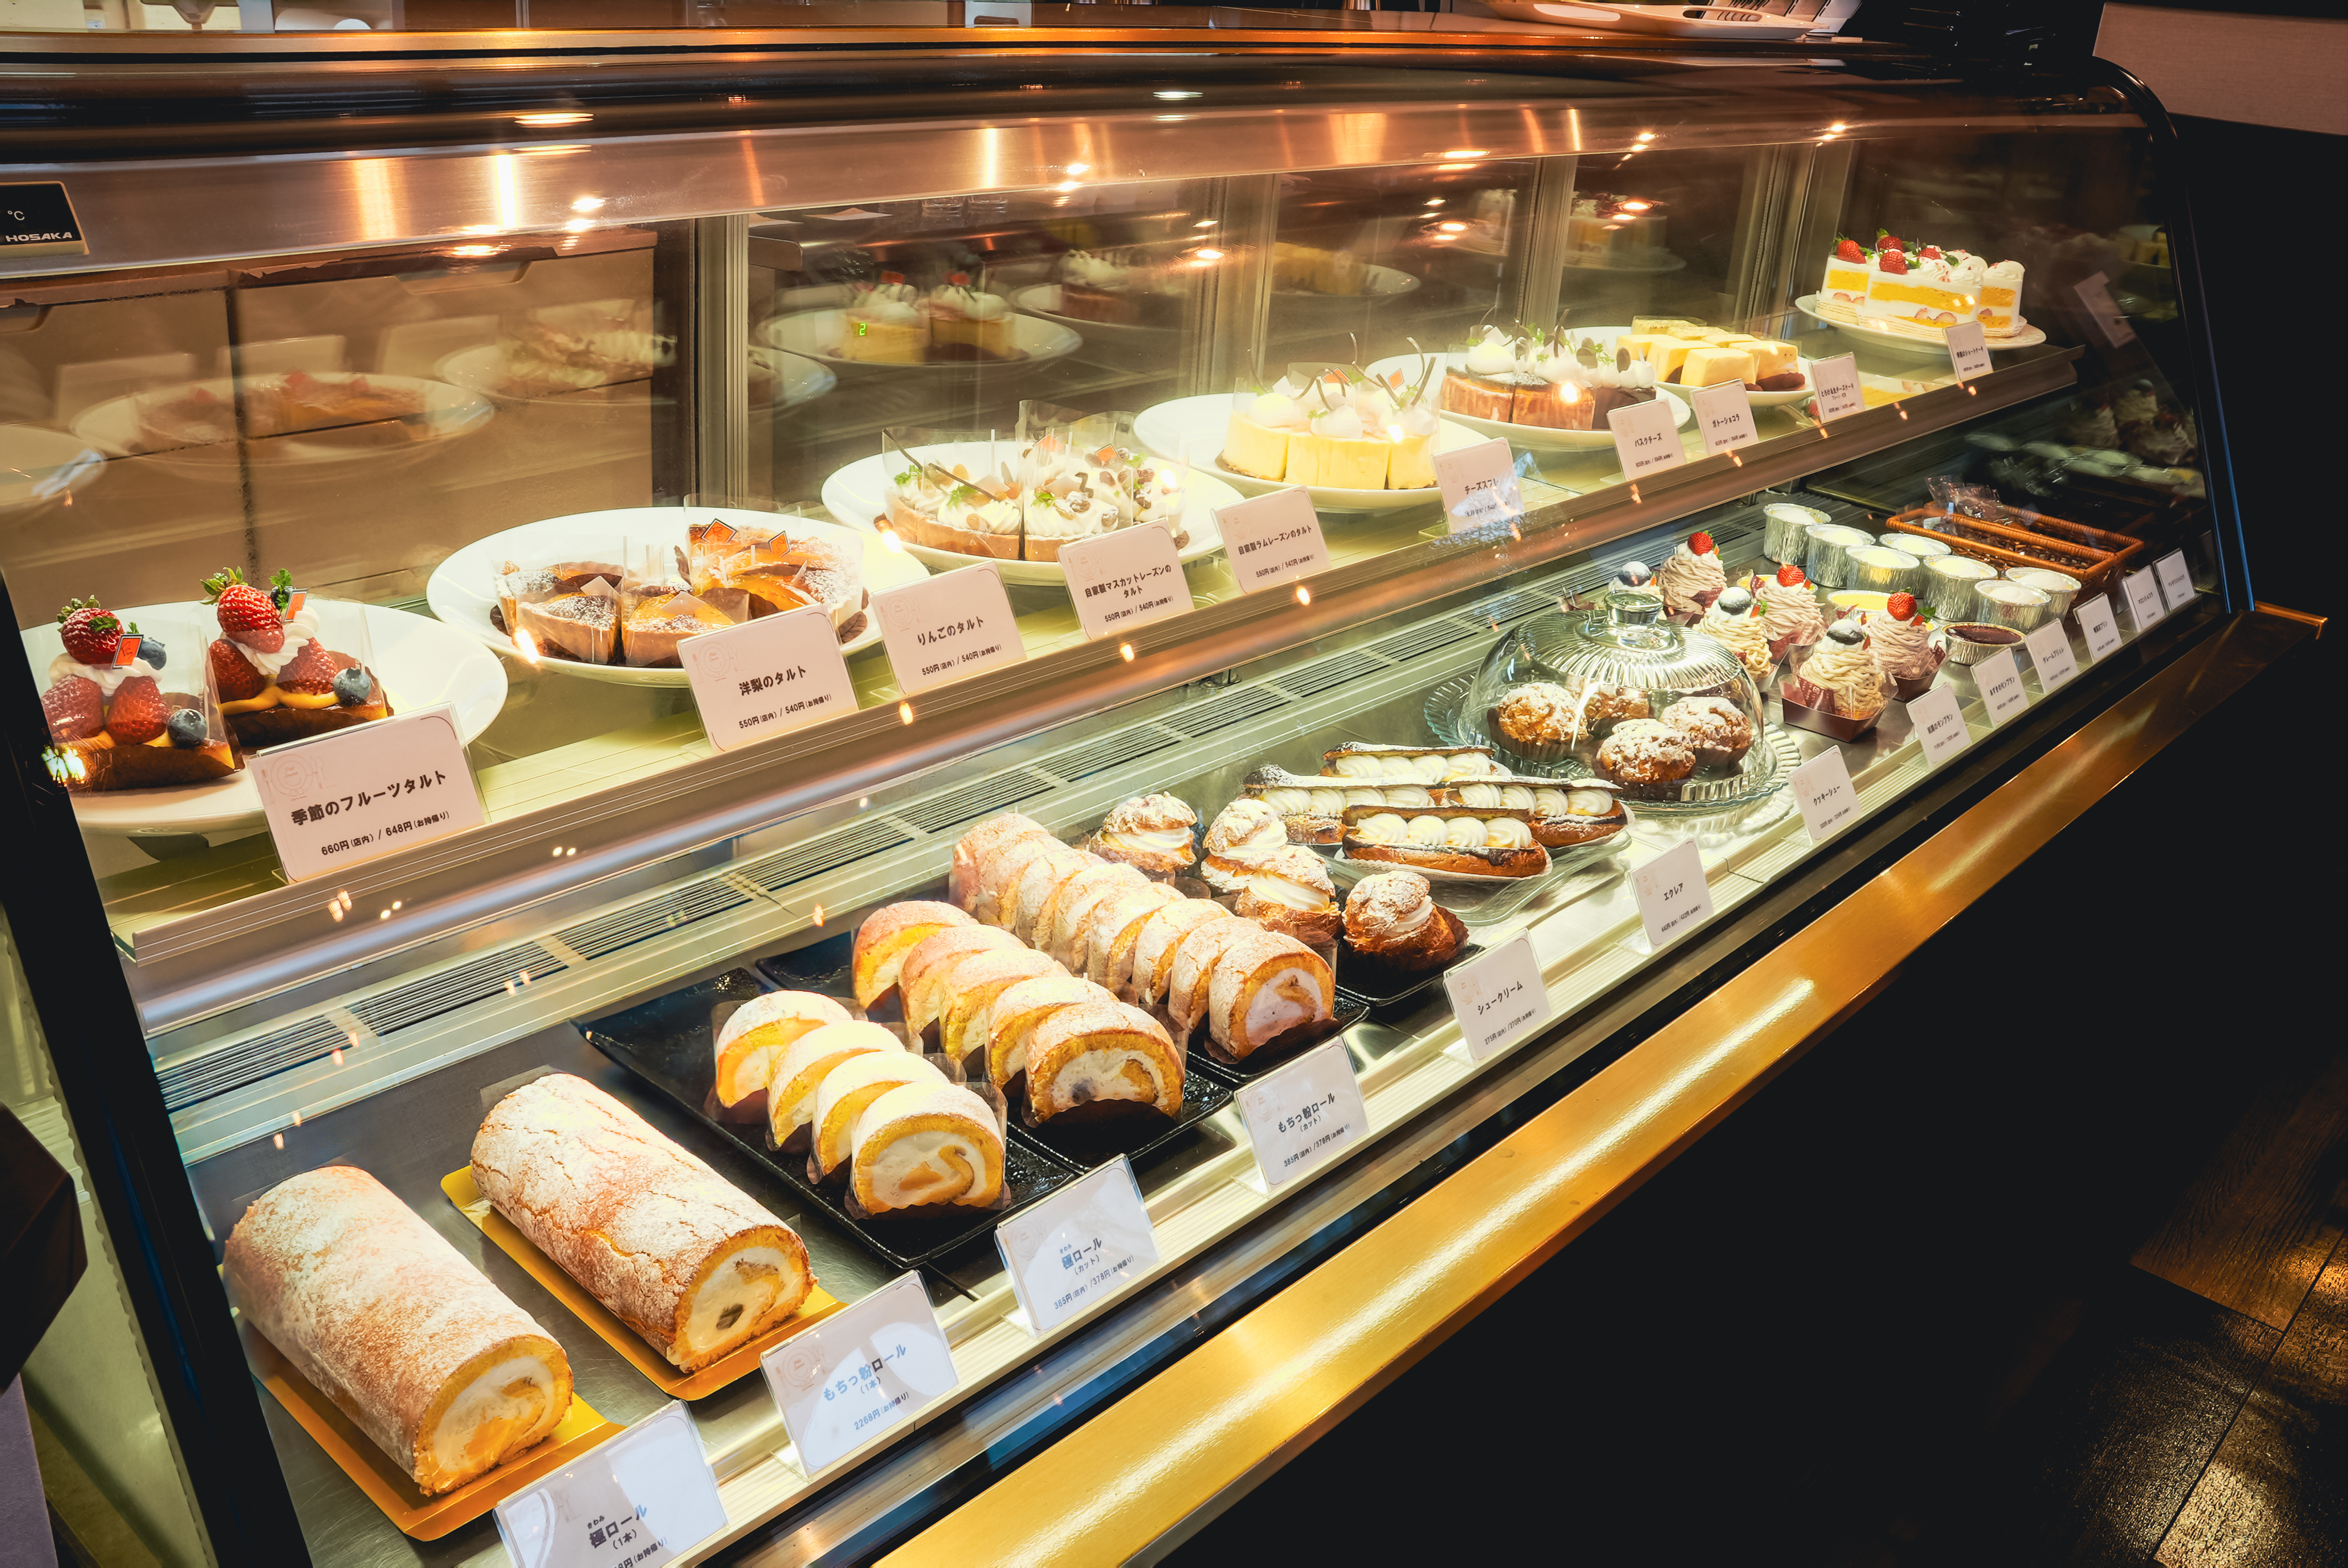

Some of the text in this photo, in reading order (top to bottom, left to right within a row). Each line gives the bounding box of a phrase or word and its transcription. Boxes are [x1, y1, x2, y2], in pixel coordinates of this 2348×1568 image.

[6, 232, 73, 242] HOSAKA
[1712, 413, 1739, 427] ガトーショコラ
[1635, 432, 1662, 447] バスクチーズ
[1238, 525, 1311, 555] 自家製ラムレーズンのタルト
[1084, 564, 1171, 597] 自家製マスカットレーズンの
[1124, 585, 1142, 598] タルト
[917, 616, 983, 645] りんごのタルト
[739, 666, 805, 696] 洋梨のタルト
[291, 770, 445, 826] 季節のフルーツタルト
[1813, 786, 1840, 806] クッキーシュー
[1664, 883, 1682, 900] エクレア
[1477, 981, 1522, 1015] シュークリーム
[1278, 1092, 1335, 1132] もちっ粉ロール
[1062, 1237, 1101, 1270] 極ロール
[823, 1344, 905, 1400] もちっ粉ロール
[589, 1504, 646, 1548] 極ロール
